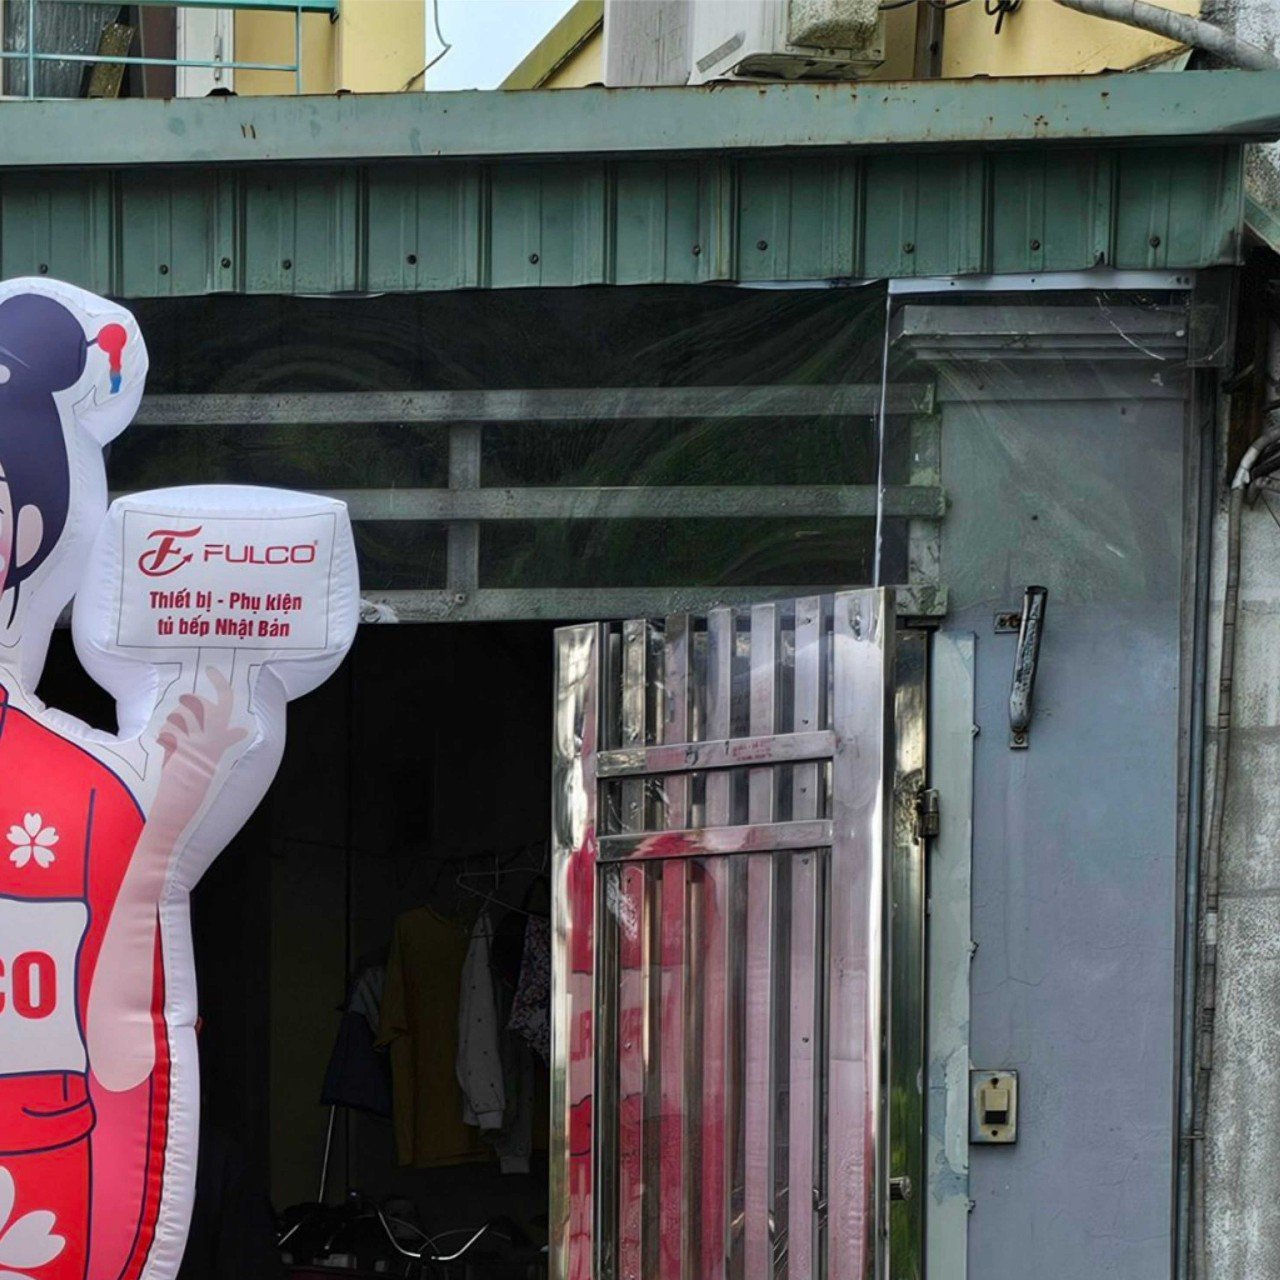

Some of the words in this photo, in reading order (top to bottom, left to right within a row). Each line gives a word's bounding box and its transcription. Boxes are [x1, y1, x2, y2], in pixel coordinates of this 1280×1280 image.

[204, 544, 315, 565] FULCO
[149, 588, 191, 609] Thiết
[196, 591, 213, 612] bị
[229, 592, 261, 614] Phụ
[265, 594, 302, 614] kiện
[158, 616, 174, 635] tủ
[179, 615, 210, 637] bếp
[215, 618, 254, 639] Nhật
[258, 618, 290, 637] Bản
